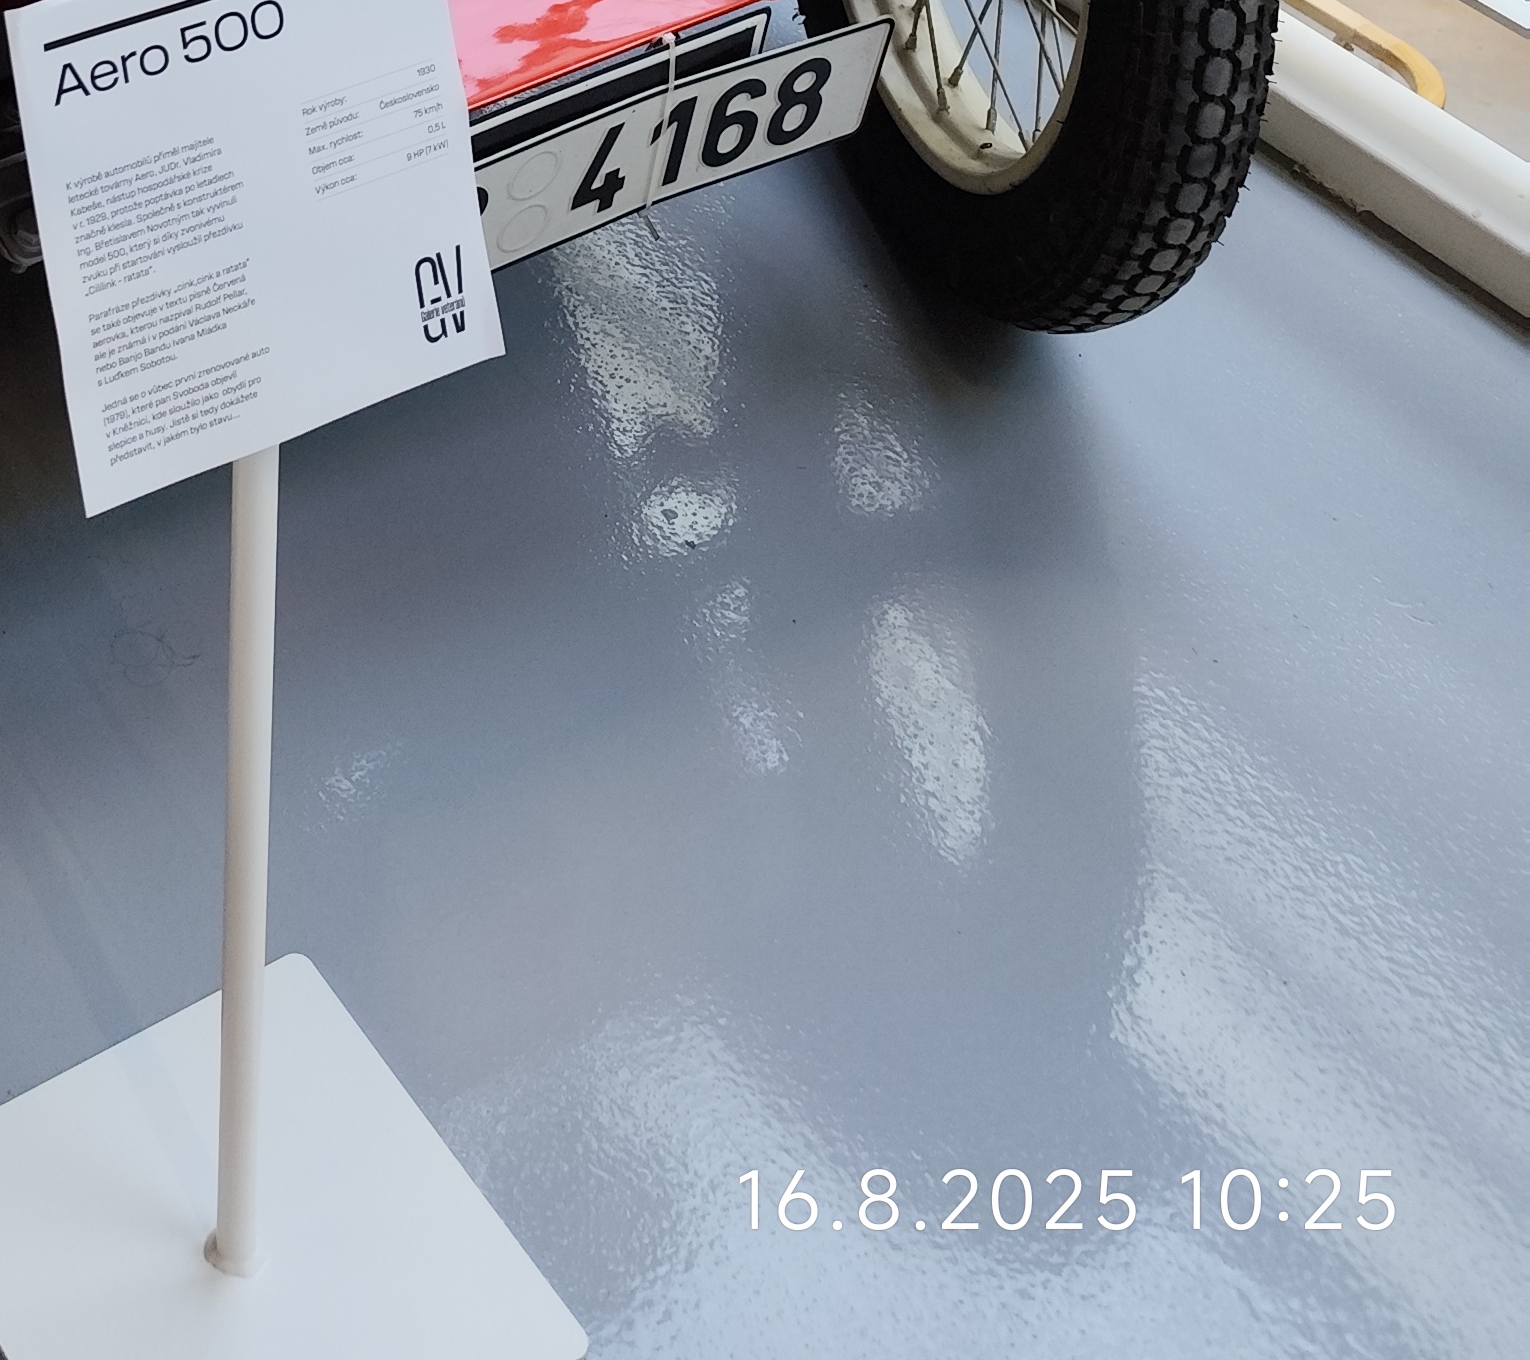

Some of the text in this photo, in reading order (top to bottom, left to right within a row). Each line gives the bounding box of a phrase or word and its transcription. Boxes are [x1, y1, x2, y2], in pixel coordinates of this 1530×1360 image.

[54, 0, 284, 107] Aero 500
[301, 63, 436, 116] Rok výroby: 1930
[304, 83, 440, 136] Země původu: Československo
[308, 102, 443, 155] Max. rychlost: 75 km/h
[311, 160, 337, 175] Objem
[338, 154, 355, 166] cca:
[427, 122, 441, 134] 0,5
[570, 57, 832, 213] 4168
[67, 148, 222, 204] letecké továrny Aero, JUDr. Vladimíra
[73, 171, 103, 189] výrobě
[104, 155, 152, 179] automobilů
[153, 146, 180, 164] přiměl
[180, 136, 214, 153] majitele
[105, 189, 137, 205] nástup
[136, 170, 191, 195] hospodářské
[191, 164, 213, 177] krize
[314, 180, 340, 195] Výkon
[340, 173, 357, 185] cca:
[412, 148, 424, 159] HP
[74, 225, 106, 244] značně
[106, 218, 135, 232] klesla.
[135, 202, 175, 223] Společně
[182, 181, 244, 207] konstruktérem
[85, 211, 110, 225] 1929,
[110, 201, 143, 219] protože
[144, 187, 183, 208] poptávka
[184, 183, 195, 195] po
[196, 170, 234, 189] letadlech
[76, 246, 94, 257] Ing.
[146, 213, 190, 233] Novotným
[190, 207, 205, 218] tak
[206, 195, 237, 214] vyvinuli
[79, 253, 106, 270] model
[106, 247, 128, 261] 500,
[128, 238, 151, 253] který
[161, 230, 179, 242] díky
[81, 222, 243, 284] zvuku při startování vysloužil přezdívku
[88, 302, 130, 323] Parafráze
[131, 288, 172, 310] přezdívky
[90, 326, 101, 336] se
[102, 318, 121, 332] také
[122, 306, 158, 325] objevuje
[165, 296, 188, 309] textu
[188, 285, 211, 303] písně
[212, 273, 246, 292] Červená
[92, 288, 248, 349] aerovka, kterou nazpíval Rudolf Pellar,
[94, 351, 107, 361] ale
[107, 347, 116, 359] je
[117, 335, 147, 354] známá
[158, 320, 187, 340] podání
[187, 311, 221, 327] Václava
[221, 297, 255, 315] Neckáře
[95, 361, 117, 374] nebo
[118, 351, 143, 366] Banjo
[143, 342, 171, 357] Bandu
[172, 333, 195, 347] Ivana
[101, 396, 128, 413] Jedná
[128, 393, 139, 402] se
[147, 381, 174, 395] vůbec
[174, 371, 196, 388] první
[197, 352, 250, 378] zrenovované
[251, 346, 270, 359] auto
[139, 353, 178, 372] Sobotou.
[131, 400, 154, 415] které
[154, 395, 171, 408] pan
[172, 381, 210, 400] Svoboda
[210, 369, 237, 387] objevil
[151, 410, 167, 421] kde
[168, 398, 201, 415] sloužilo
[201, 391, 219, 406] jako
[221, 379, 247, 396] obydlí
[247, 376, 261, 388] pro
[107, 435, 137, 452] slepice
[144, 424, 168, 437] husy.
[169, 413, 190, 428] Jistě
[199, 405, 219, 417] tedy
[219, 391, 258, 410] dokážete
[109, 442, 155, 467] představit,
[162, 429, 189, 446] jakém
[189, 422, 208, 435] bylo
